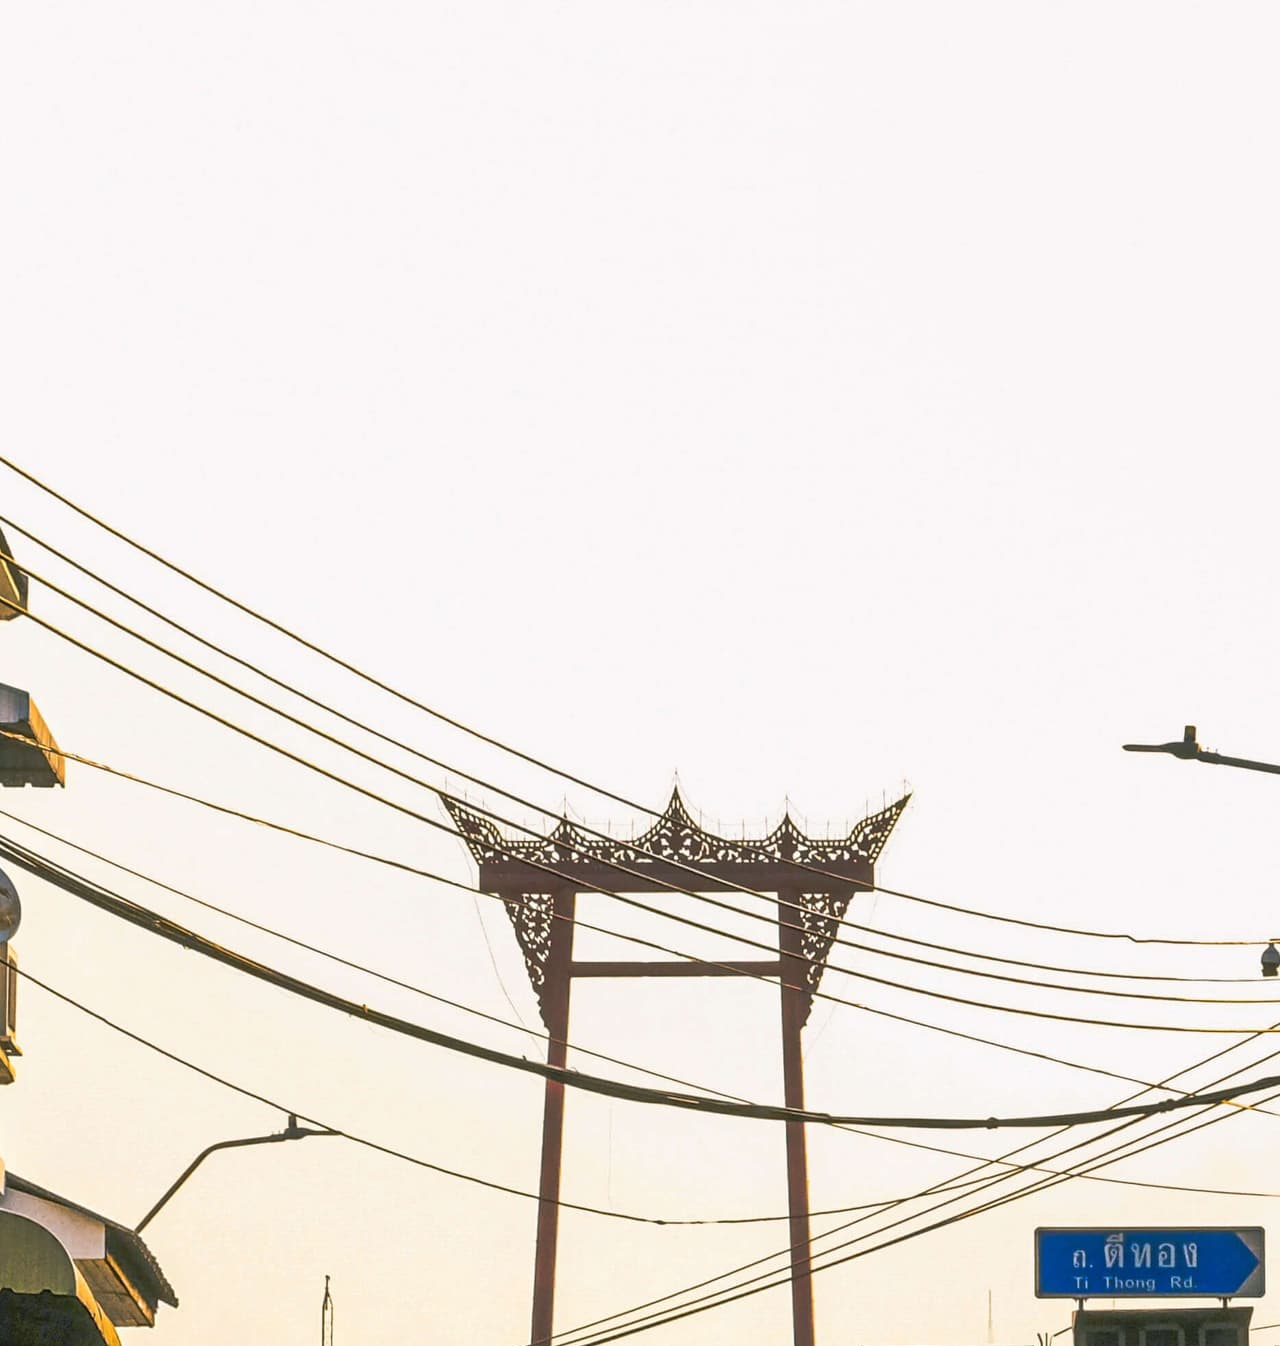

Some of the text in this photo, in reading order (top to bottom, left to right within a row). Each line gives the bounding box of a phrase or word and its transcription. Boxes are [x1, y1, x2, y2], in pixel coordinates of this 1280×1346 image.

[1072, 1233, 1199, 1269] ถ. ตีทอง
[1073, 1276, 1198, 1291] Ti Thong Rd.
